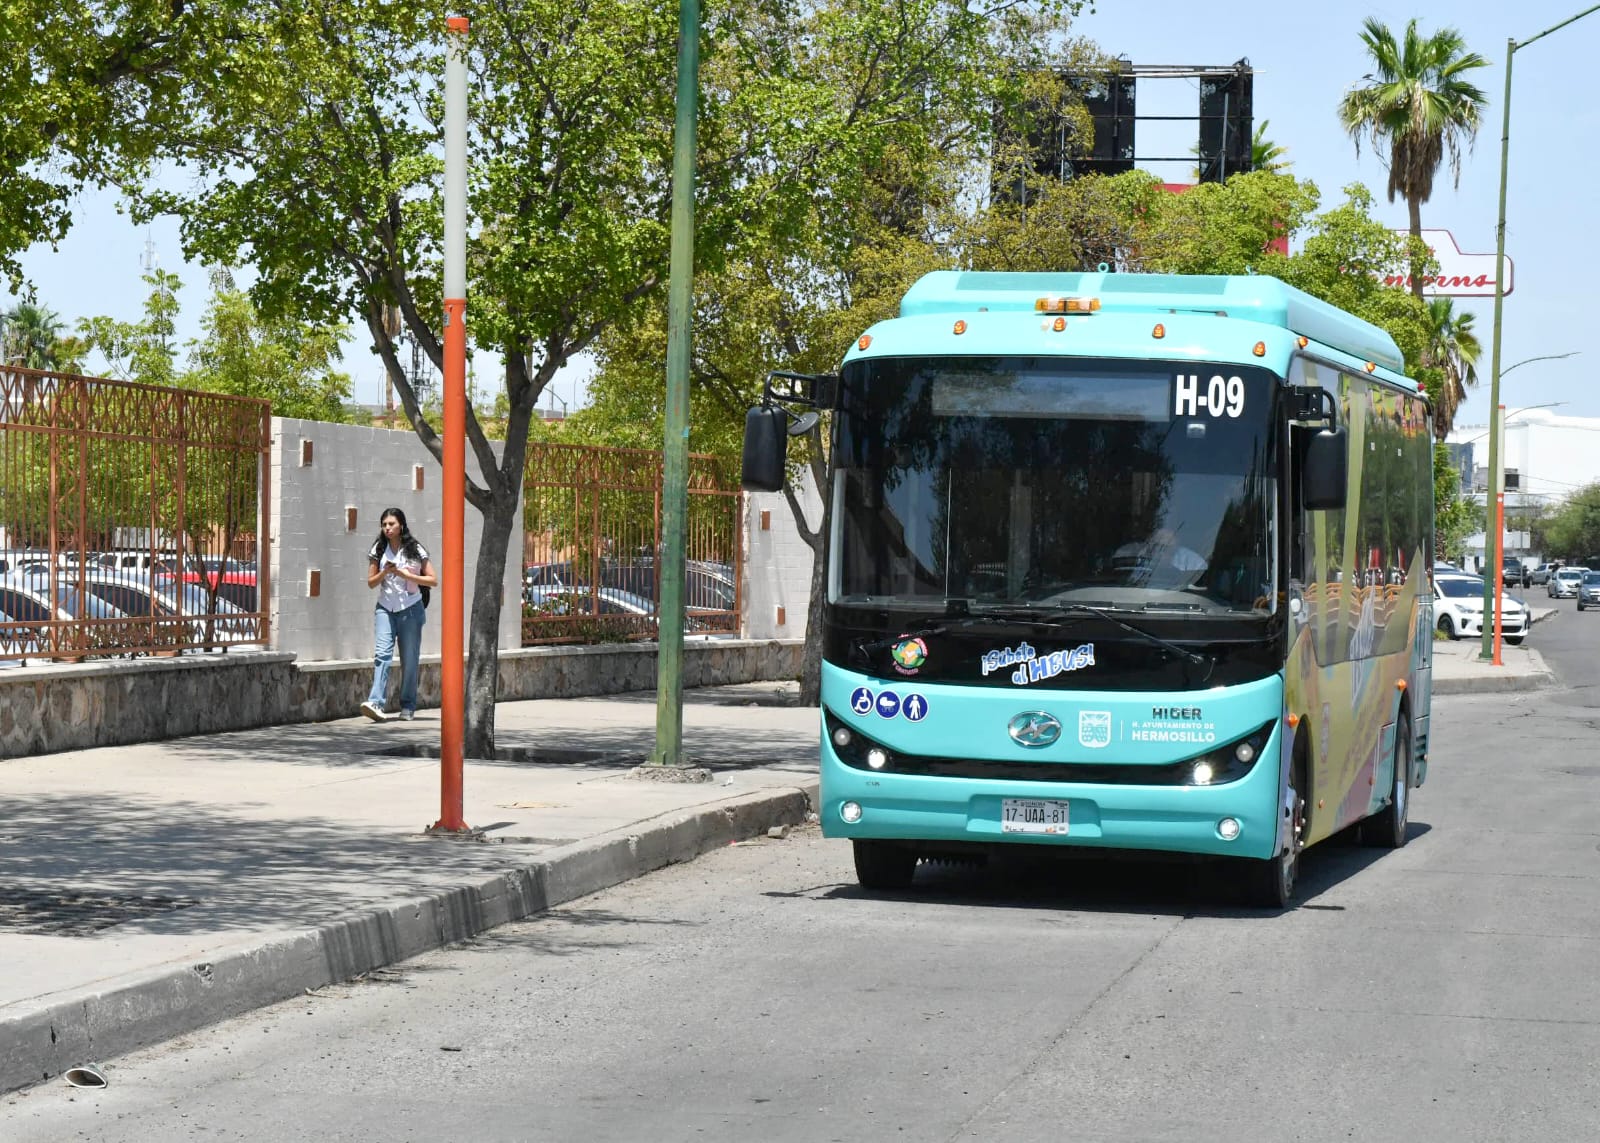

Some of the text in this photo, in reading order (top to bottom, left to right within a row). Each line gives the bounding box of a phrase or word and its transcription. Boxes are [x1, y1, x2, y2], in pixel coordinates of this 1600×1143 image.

[1175, 374, 1245, 418] H-09
[1012, 643, 1095, 685] al HBUS!
[1152, 707, 1203, 721] HIGER
[1142, 721, 1202, 730] AYUNTAMIENTO
[1203, 722, 1215, 730] DE
[1131, 730, 1216, 743] HERMOSILLO
[1005, 808, 1066, 824] 17-UAA-81
